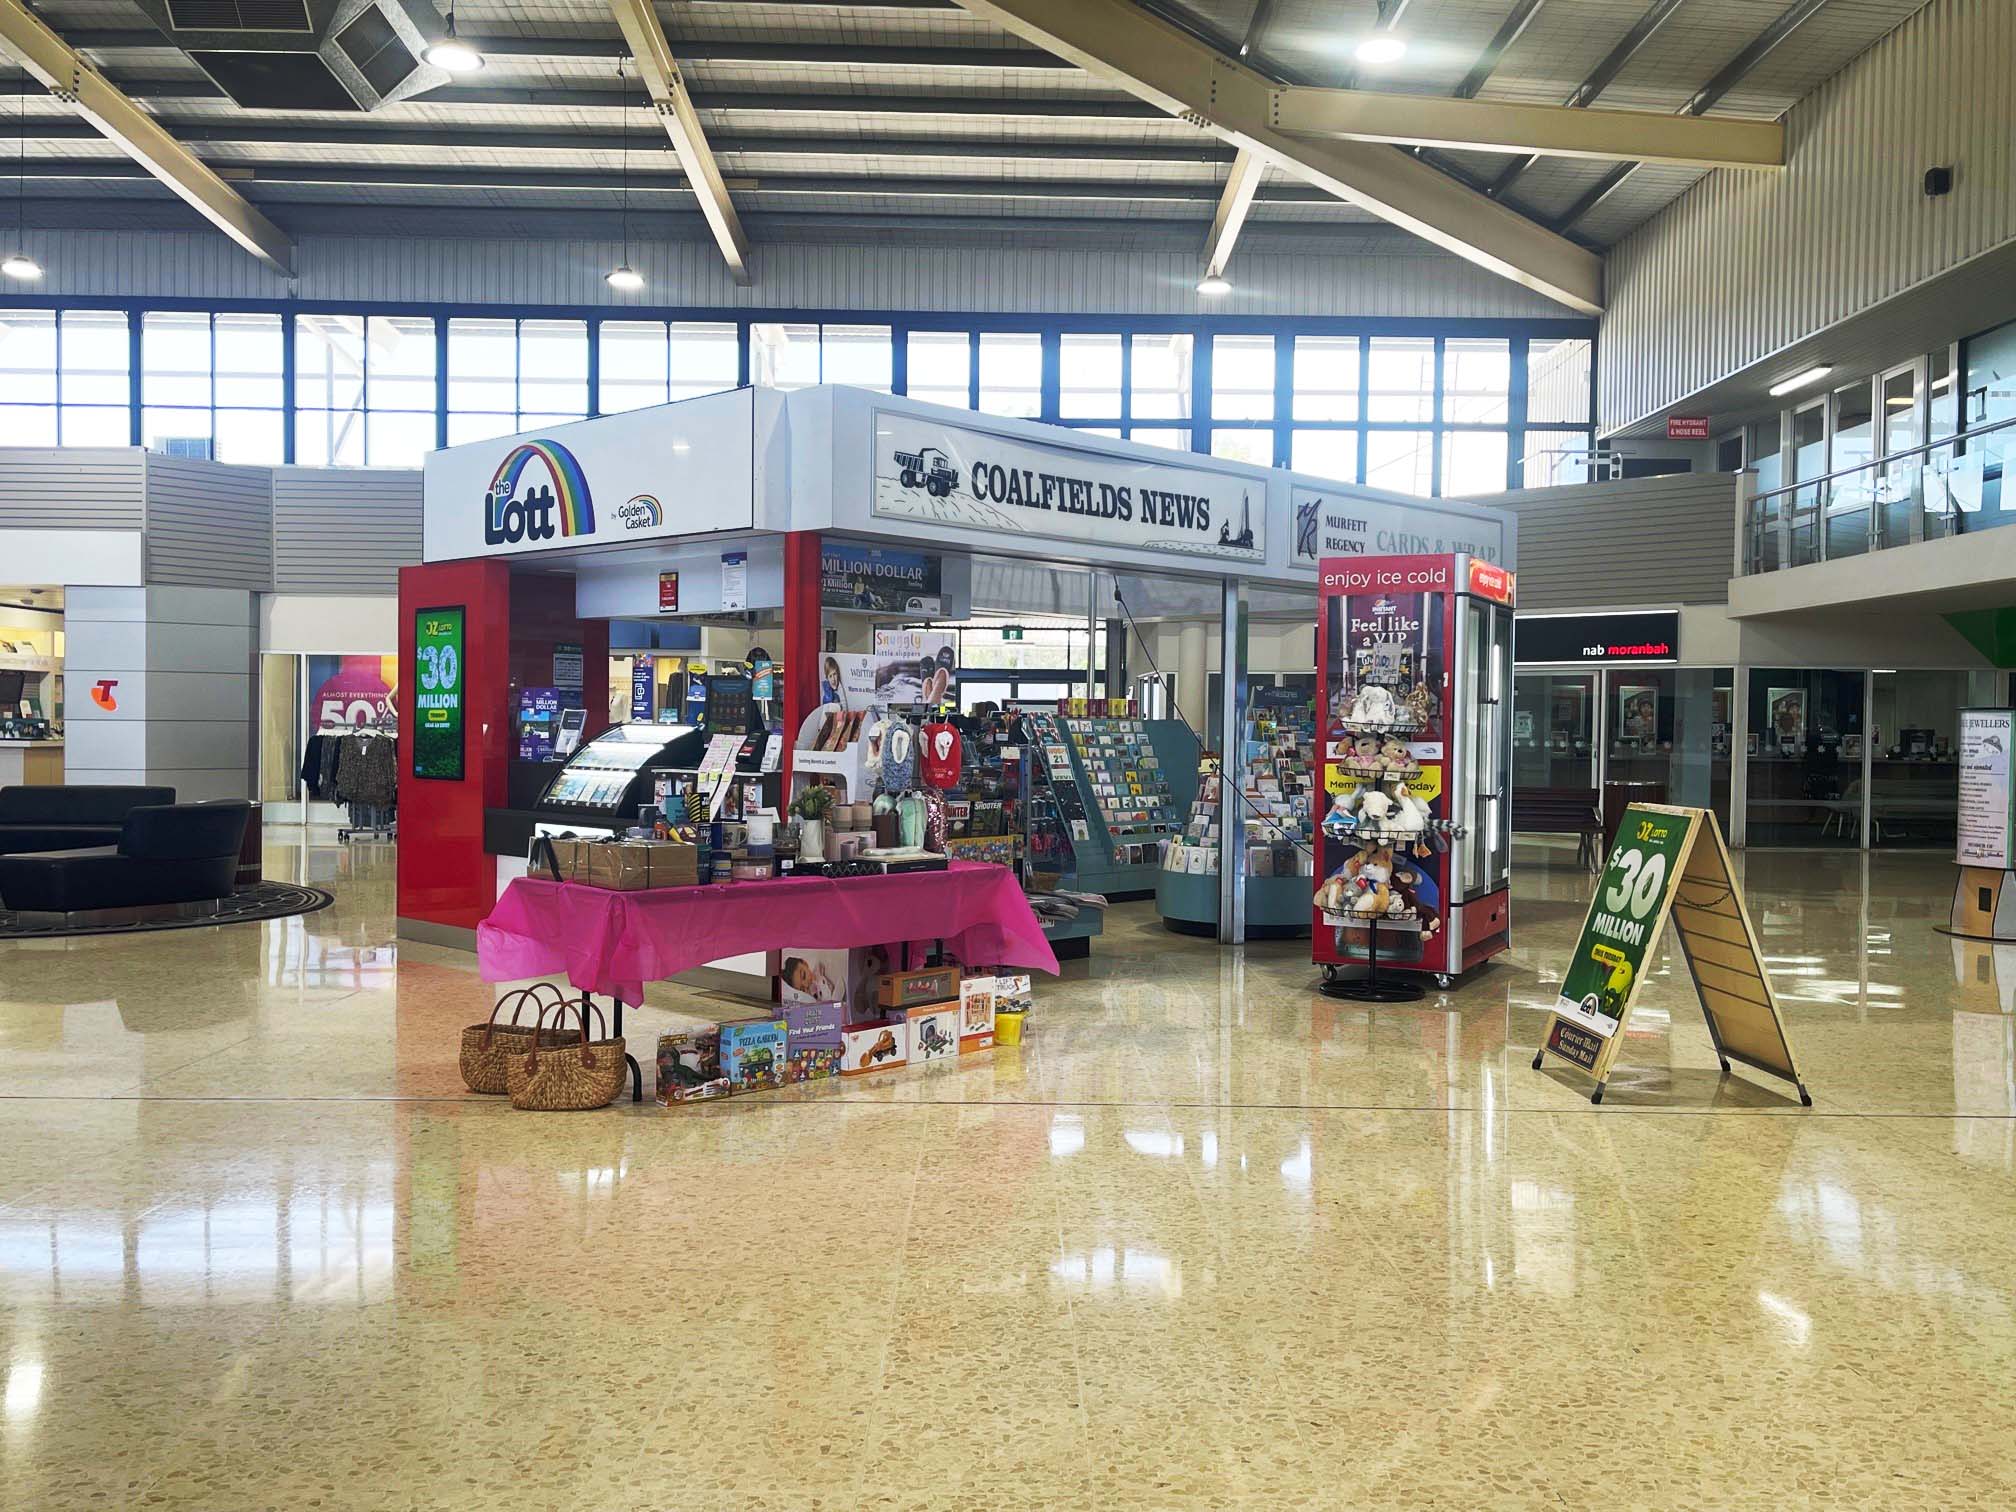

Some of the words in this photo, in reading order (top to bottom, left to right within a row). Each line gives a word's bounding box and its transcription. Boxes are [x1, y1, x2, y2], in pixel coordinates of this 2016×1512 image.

[495, 480, 511, 494] the
[971, 461, 1133, 522] COALFIELDS
[1140, 489, 1211, 532] NEWS
[485, 485, 555, 545] Lott
[618, 504, 646, 518] Golden
[625, 516, 651, 530] Casket
[1325, 515, 1368, 533] MURFETT
[1325, 537, 1366, 554] REGENCY
[1376, 530, 1430, 554] CARDS
[1434, 539, 1445, 554] &
[821, 558, 872, 576] MILLION
[876, 564, 922, 580] DOLLAR
[1324, 571, 1371, 588] enjoy
[1377, 569, 1401, 585] ice
[1407, 567, 1446, 584] cold
[1351, 618, 1382, 633] Feel
[1388, 616, 1420, 631] like
[877, 632, 921, 649] Snuggly
[1363, 636, 1371, 647] a
[1373, 632, 1407, 645] VIP
[894, 650, 921, 658] slippers
[1583, 644, 1605, 656] nab
[1608, 643, 1669, 656] moranbah
[417, 645, 458, 690] $30
[417, 694, 458, 709] MILLION
[1968, 719, 2010, 731] JEWELLERS
[974, 802, 1002, 811] SHOOTER
[1651, 829, 1668, 838] LOTTO
[1606, 846, 1666, 919] $30
[1592, 912, 1645, 946] MILLION
[739, 1037, 756, 1047] PIZZA
[1560, 1027, 1583, 1047] Courier
[1583, 1036, 1599, 1052] Mail
[1558, 1040, 1580, 1058] Sunday
[1579, 1048, 1594, 1065] Mail
